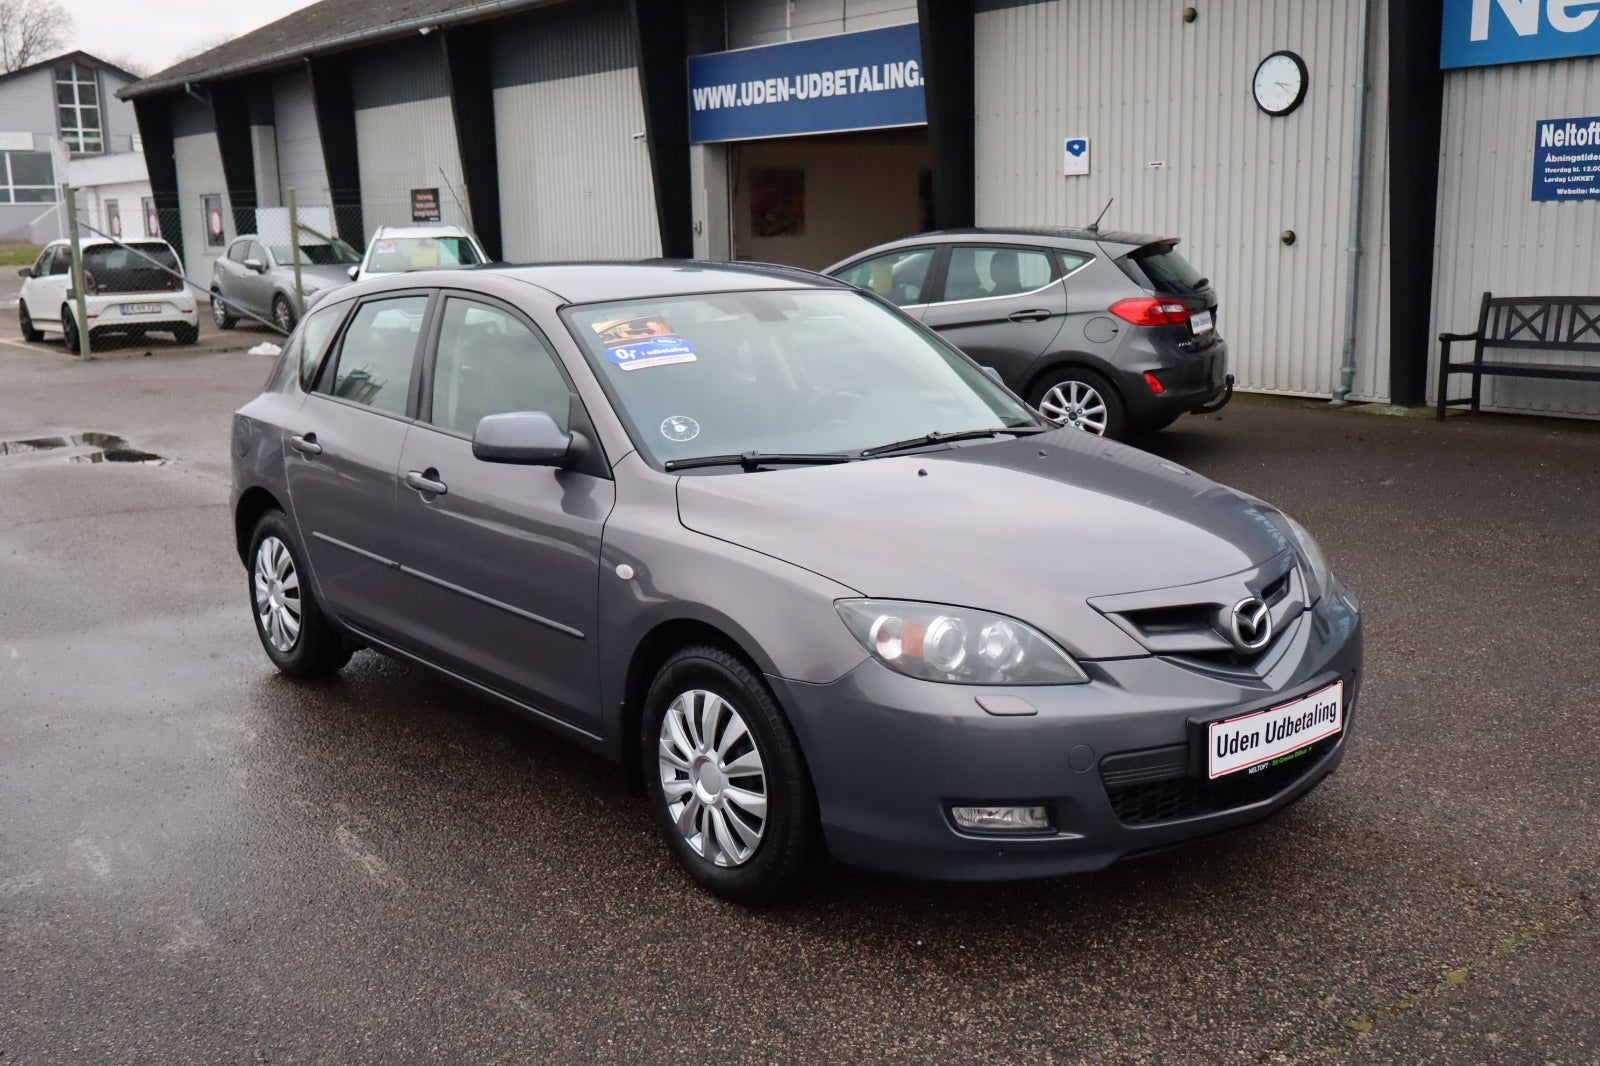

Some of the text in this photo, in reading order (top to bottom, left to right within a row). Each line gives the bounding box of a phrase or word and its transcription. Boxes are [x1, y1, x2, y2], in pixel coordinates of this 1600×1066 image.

[693, 60, 925, 111] WWW.UDEN-UDBETALING.
[1217, 701, 1336, 758] Uden Udbetaling
